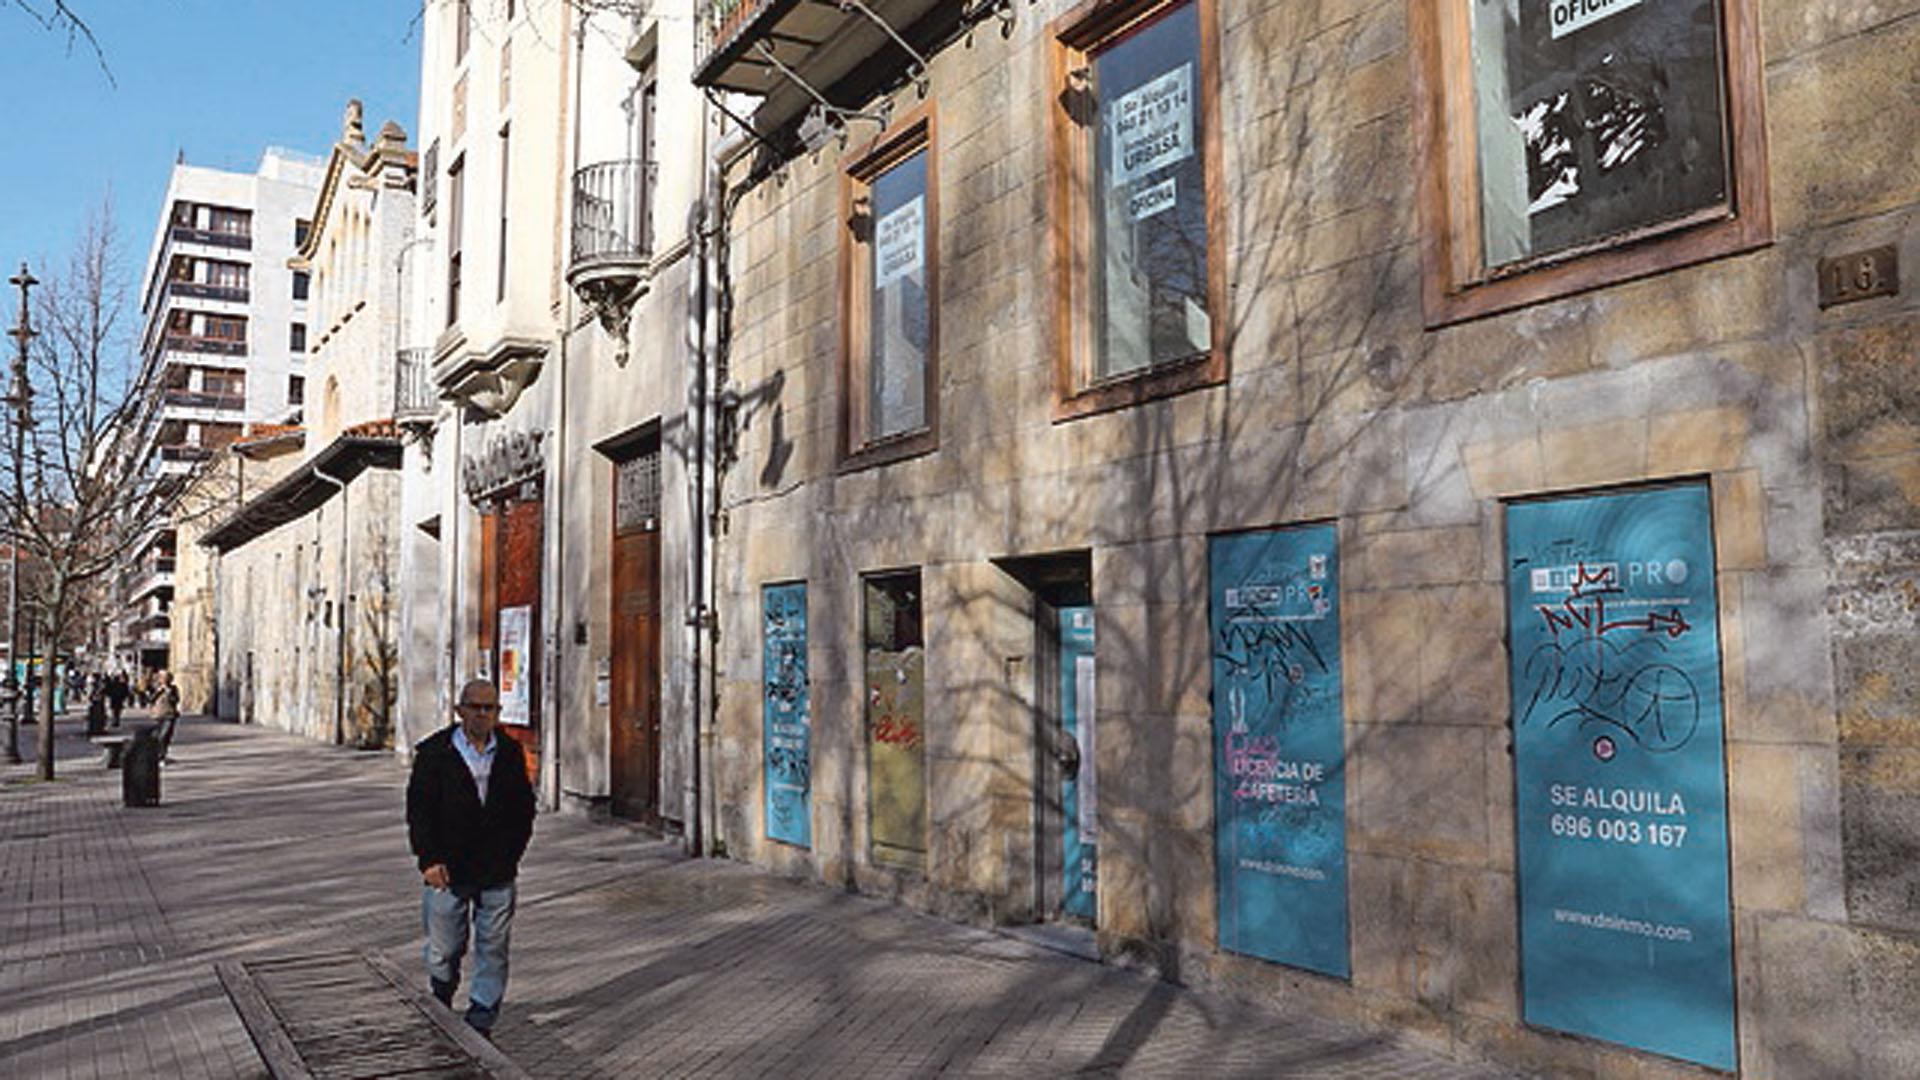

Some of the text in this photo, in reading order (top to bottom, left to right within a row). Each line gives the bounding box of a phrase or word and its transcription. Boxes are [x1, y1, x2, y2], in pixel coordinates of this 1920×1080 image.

[1130, 185, 1174, 216] OFICINA
[1303, 762, 1325, 782] DE
[1551, 783, 1686, 816] SE ALQUILA
[1551, 813, 1688, 849] 696 003 167
